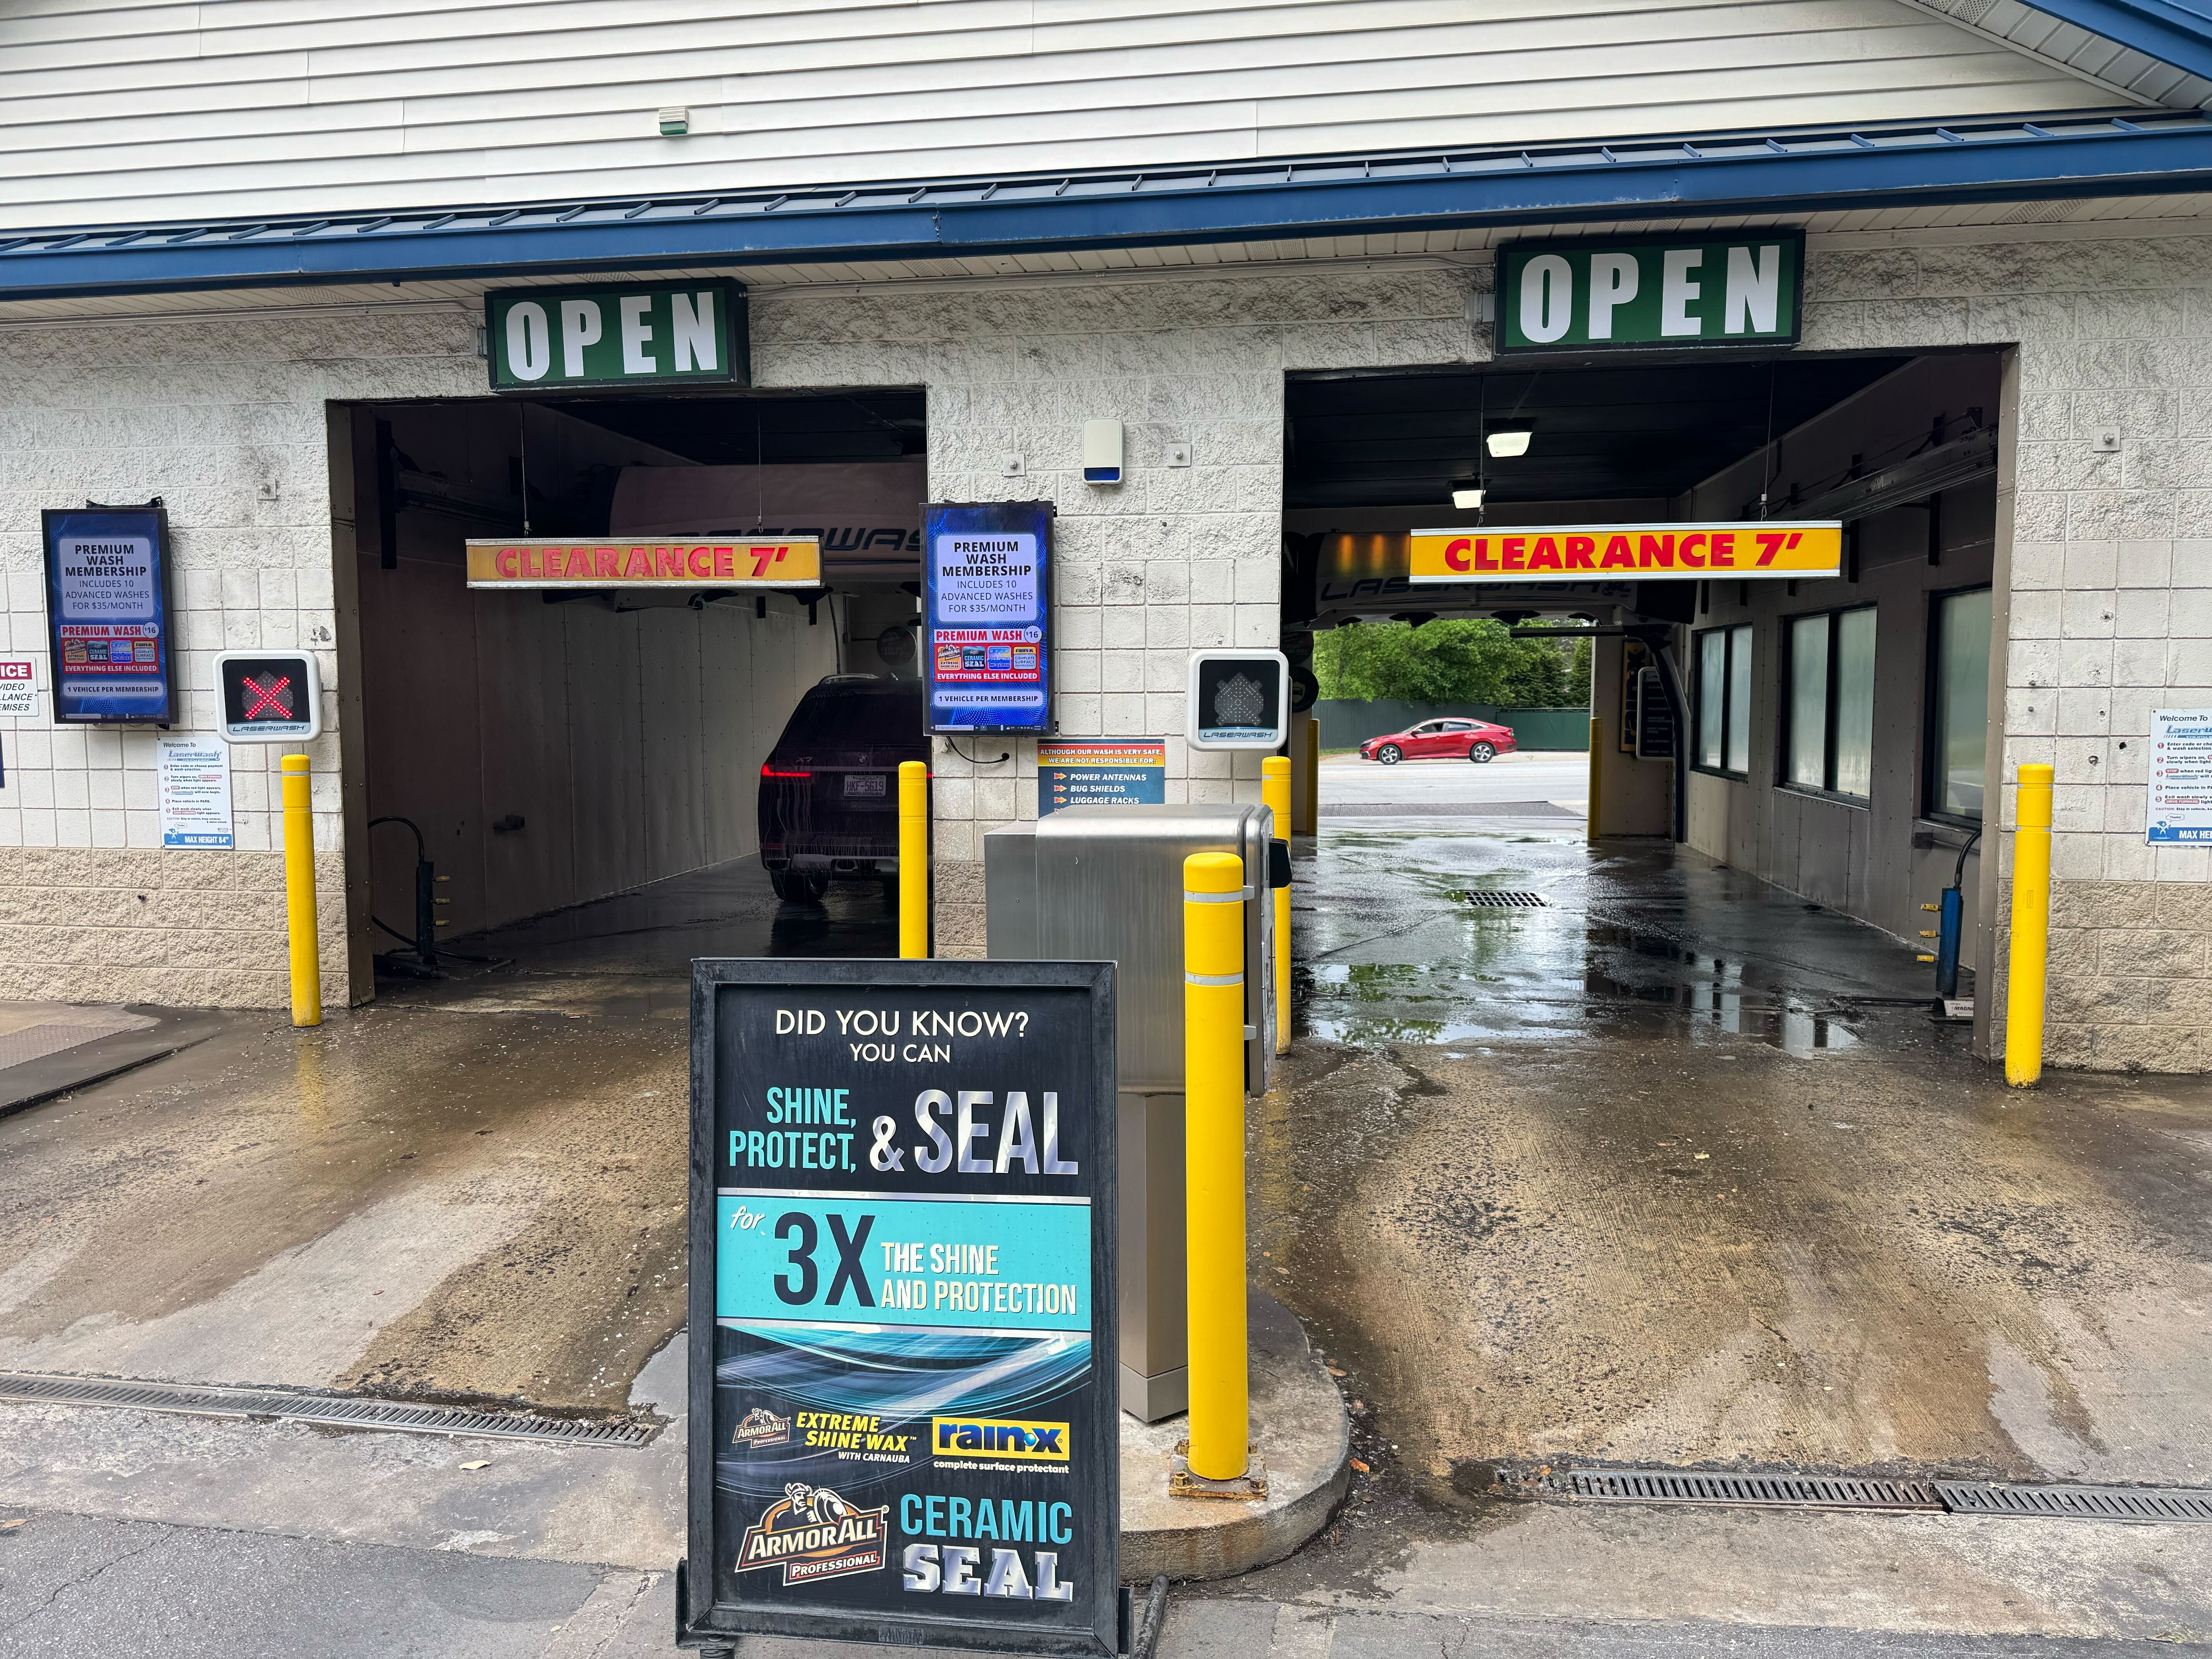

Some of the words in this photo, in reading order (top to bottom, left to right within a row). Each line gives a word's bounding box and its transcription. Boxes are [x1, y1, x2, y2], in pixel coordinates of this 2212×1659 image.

[1520, 245, 1780, 343] OPEN
[506, 292, 717, 381] OPEN
[75, 544, 134, 555] PREMIUM
[954, 541, 1018, 552] PREMIUM
[1445, 533, 1734, 572] CLEARANCE
[1756, 533, 1804, 566] 7'
[87, 556, 124, 565] WASH
[495, 547, 734, 578] CLEARANCE
[750, 547, 789, 577] 7'
[966, 553, 1006, 564] WASH
[65, 567, 146, 576] MEMBERSHIP
[943, 565, 1031, 576] MEMBERSHIP
[970, 604, 1025, 613] $35/MONTH
[62, 626, 110, 636] PREMIUM
[113, 626, 141, 635] WASH
[936, 631, 988, 641] PREMIUM
[992, 630, 1022, 640] WASH
[0, 665, 28, 677] ICE
[847, 781, 883, 791] HKF-5619
[2179, 830, 2198, 839] MAX
[776, 1010, 826, 1035] DID
[836, 1010, 900, 1036] YOU
[912, 1010, 1029, 1039] KNOW?
[850, 1044, 895, 1062] YOU
[903, 1044, 951, 1063] CAN
[767, 1087, 856, 1129] SHINE,
[869, 1115, 905, 1172] &
[914, 1089, 1079, 1176] SEAL
[730, 1131, 856, 1174] PROTECT,
[730, 1205, 766, 1231] for
[774, 1211, 876, 1307] 3X
[881, 1242, 924, 1273] THE
[930, 1243, 1000, 1276] SHINE
[881, 1279, 927, 1310] AND
[934, 1281, 1077, 1315] PROTECTION
[796, 1412, 881, 1432] EXTREME
[754, 1436, 786, 1445] PROFESSIONAL
[805, 1430, 862, 1449] SHINE
[838, 1451, 860, 1460] WITH
[863, 1453, 910, 1463] CARNAUBA
[934, 1460, 978, 1470] complete
[979, 1462, 1016, 1472] surface
[1017, 1464, 1069, 1474] protectant
[900, 1494, 1072, 1544] CERAMIC
[792, 1554, 877, 1577] PROFESSIONAL
[903, 1543, 1073, 1602] SEAL
